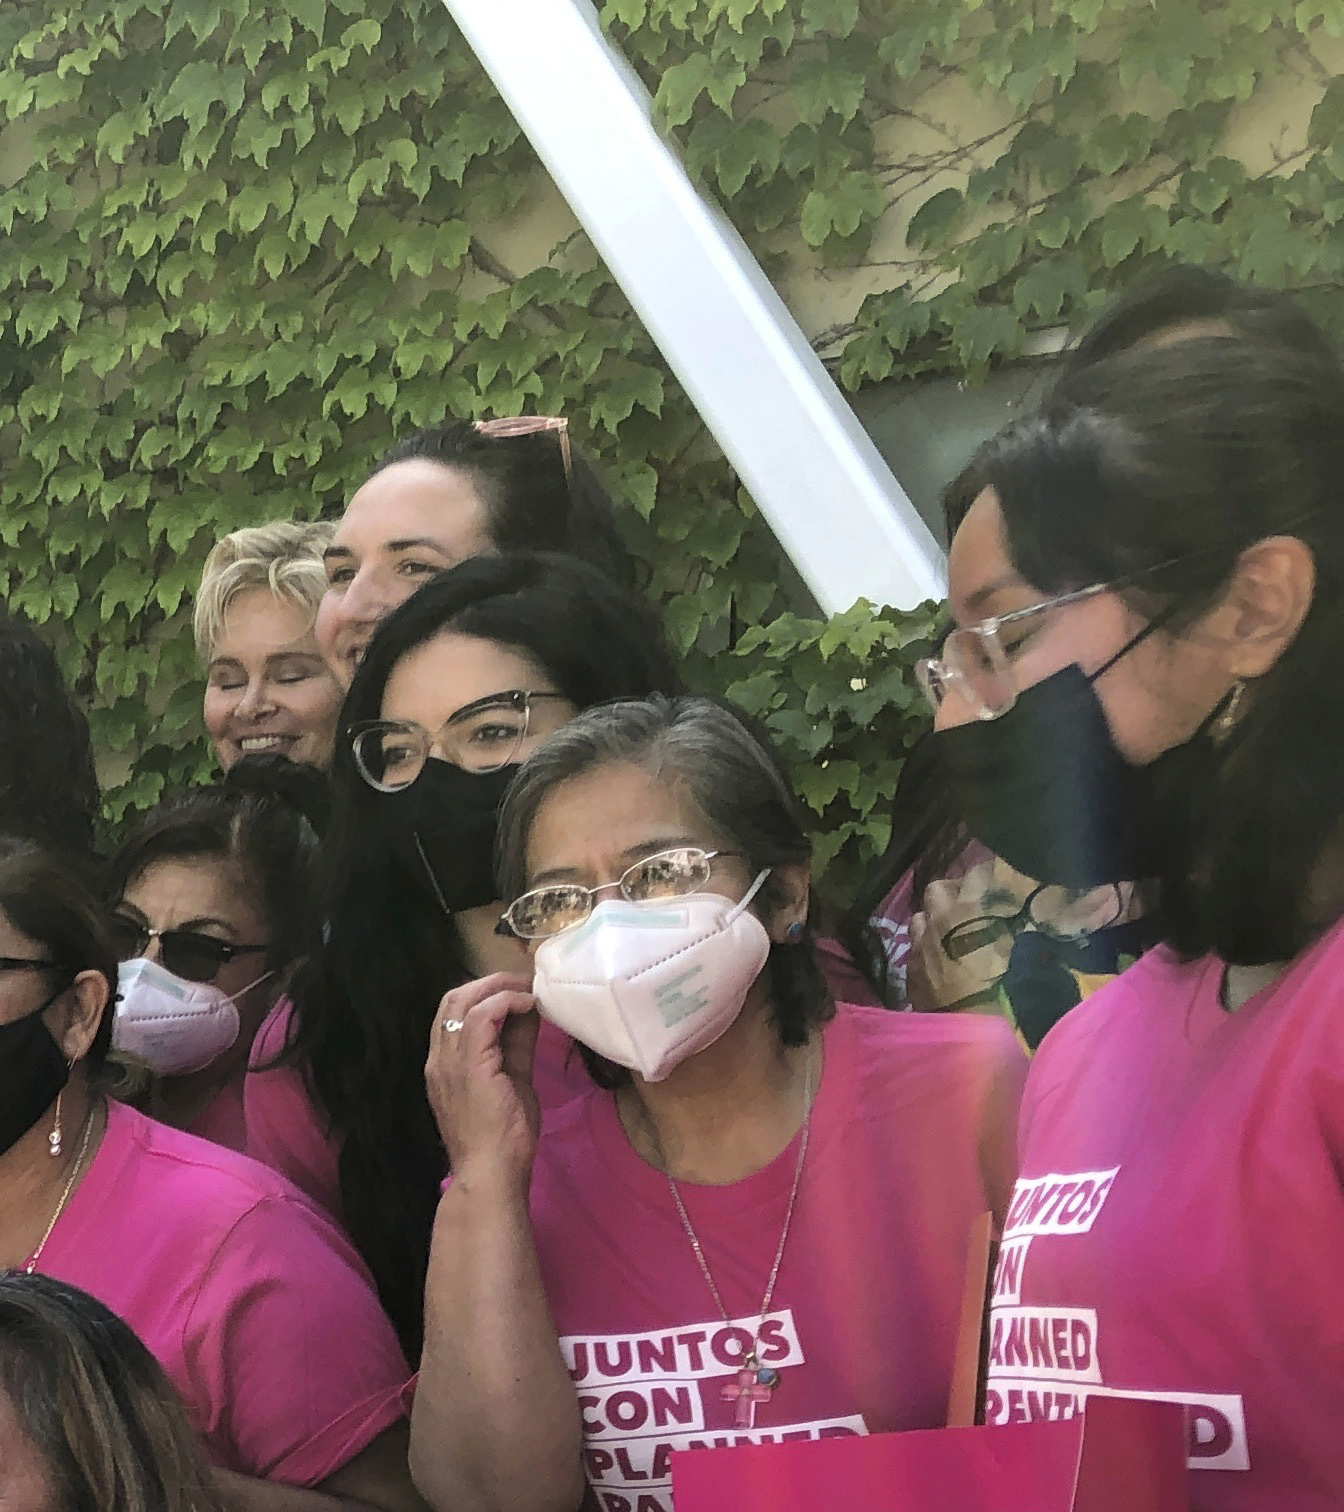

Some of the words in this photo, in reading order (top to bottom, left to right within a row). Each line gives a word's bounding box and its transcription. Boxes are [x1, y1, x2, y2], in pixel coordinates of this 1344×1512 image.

[1005, 1178, 1113, 1231] UNTOS
[569, 1319, 791, 1382] JUNTOS
[991, 1316, 1092, 1371] ANNED
[578, 1386, 693, 1434] CON
